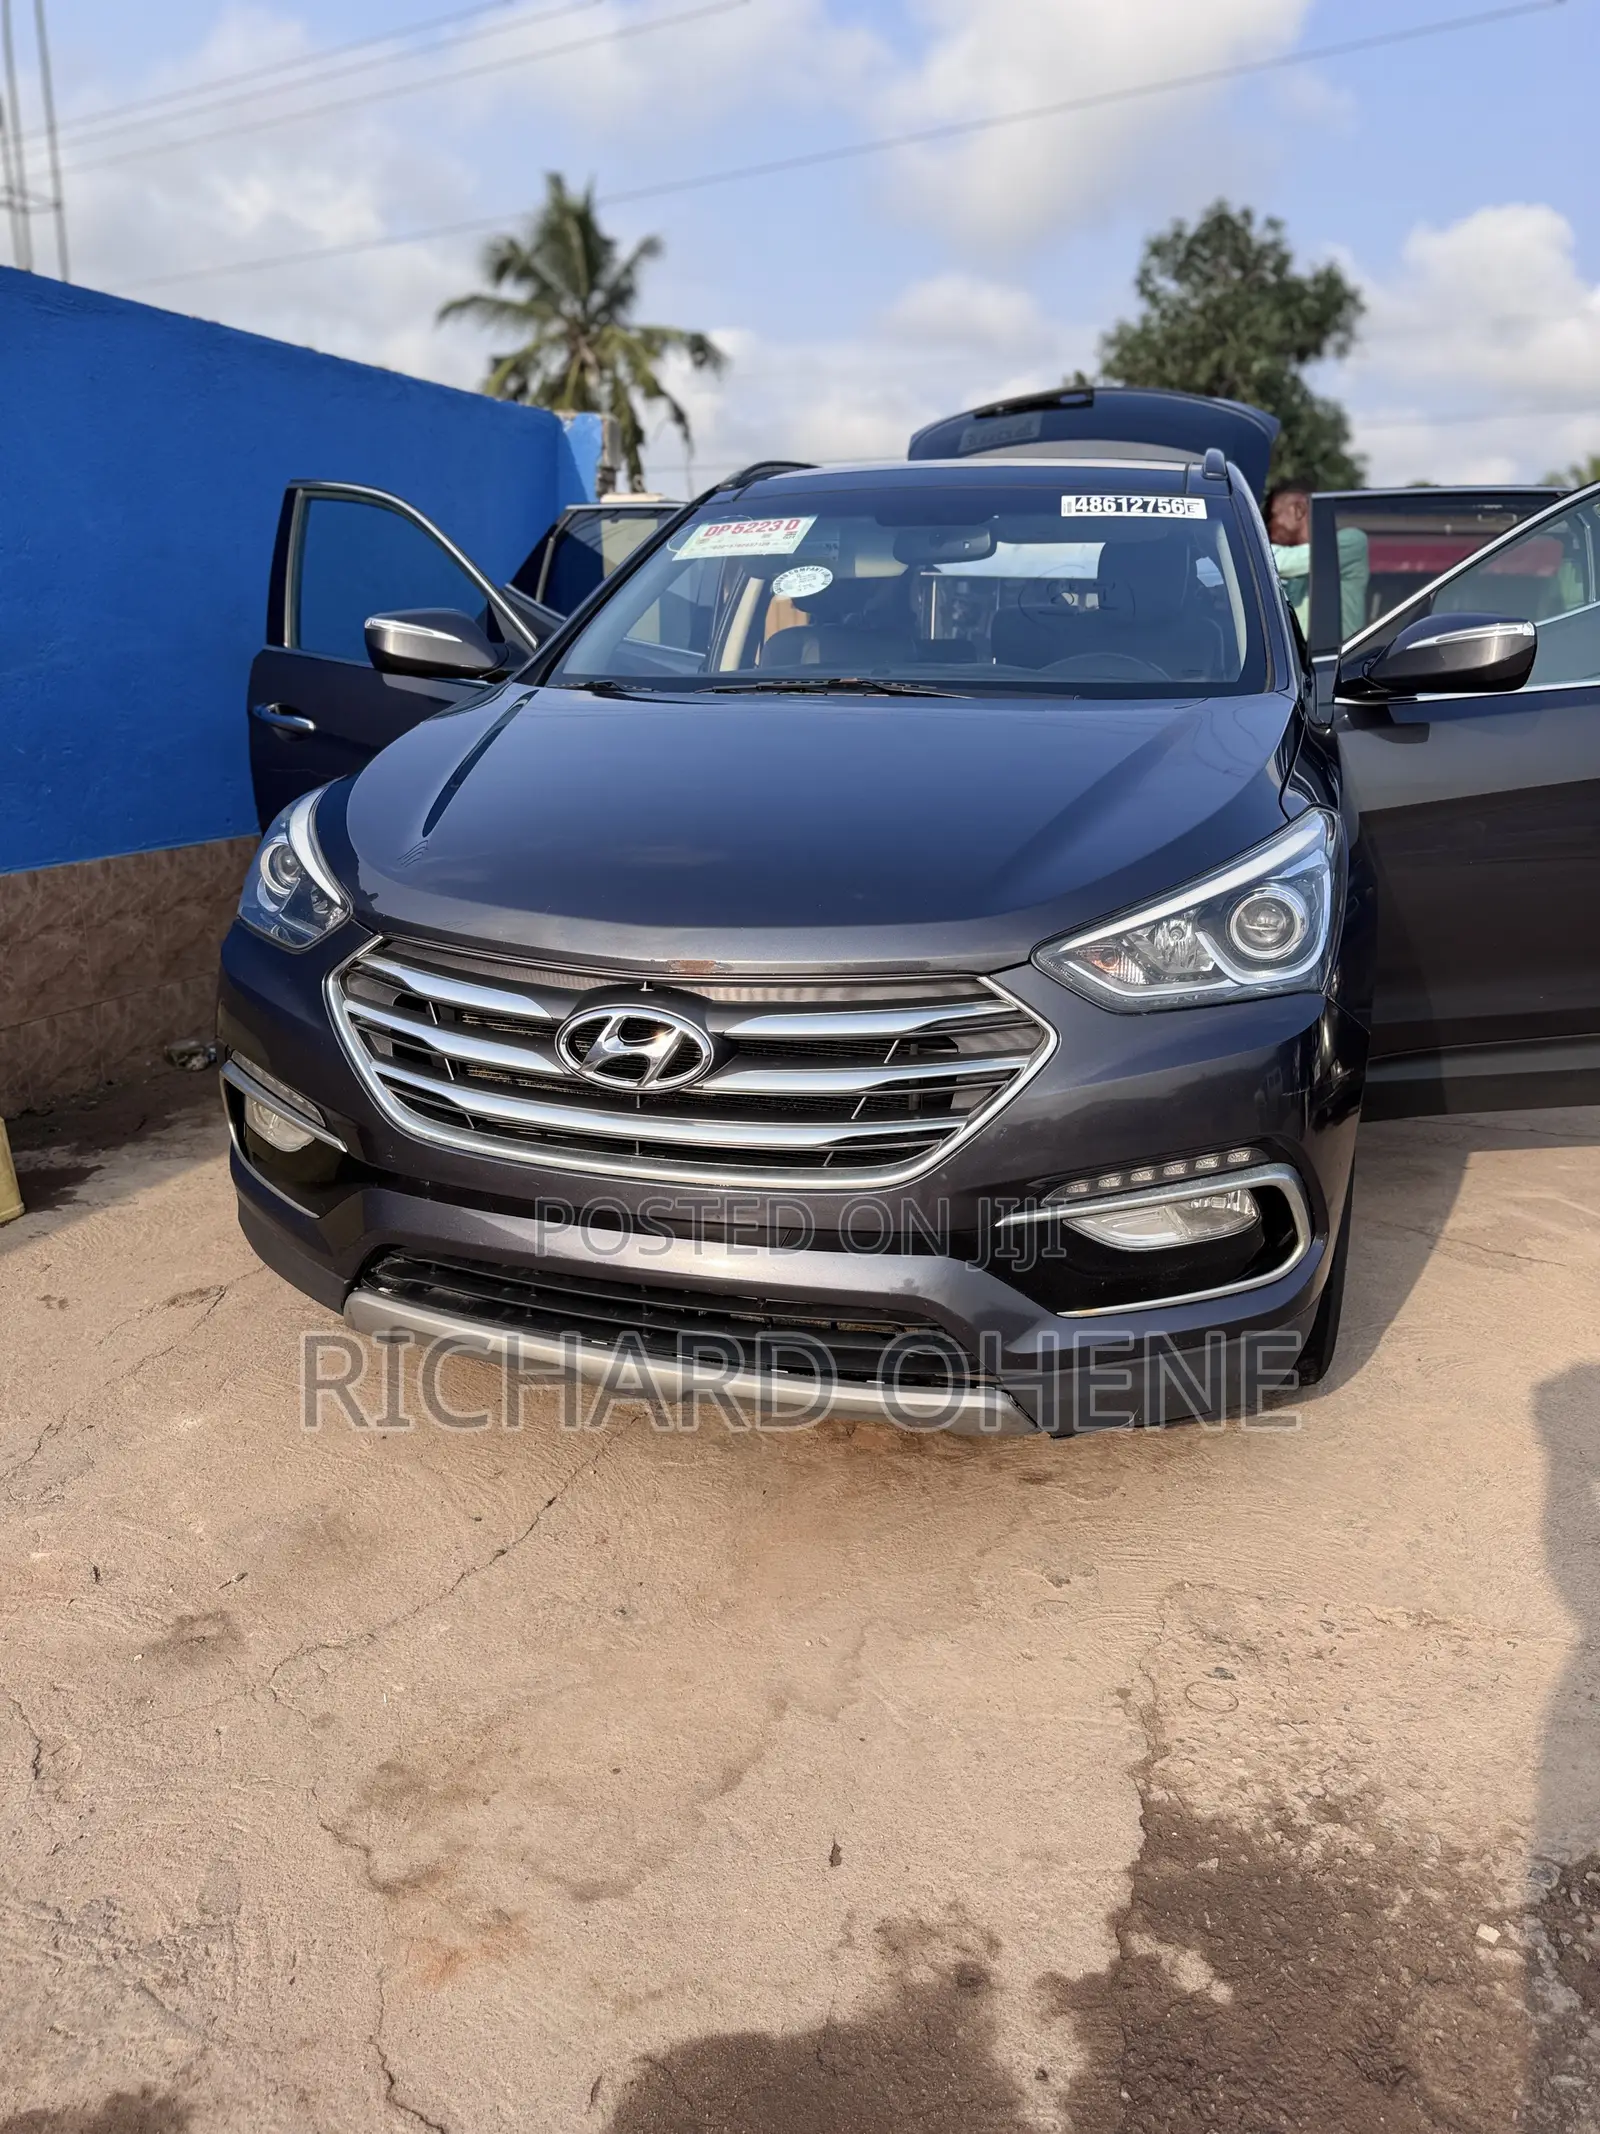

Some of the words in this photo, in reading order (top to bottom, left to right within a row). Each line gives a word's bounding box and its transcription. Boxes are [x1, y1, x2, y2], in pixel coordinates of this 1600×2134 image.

[1075, 496, 1185, 515] 48612756
[704, 524, 732, 537] DP
[731, 519, 782, 534] 5223
